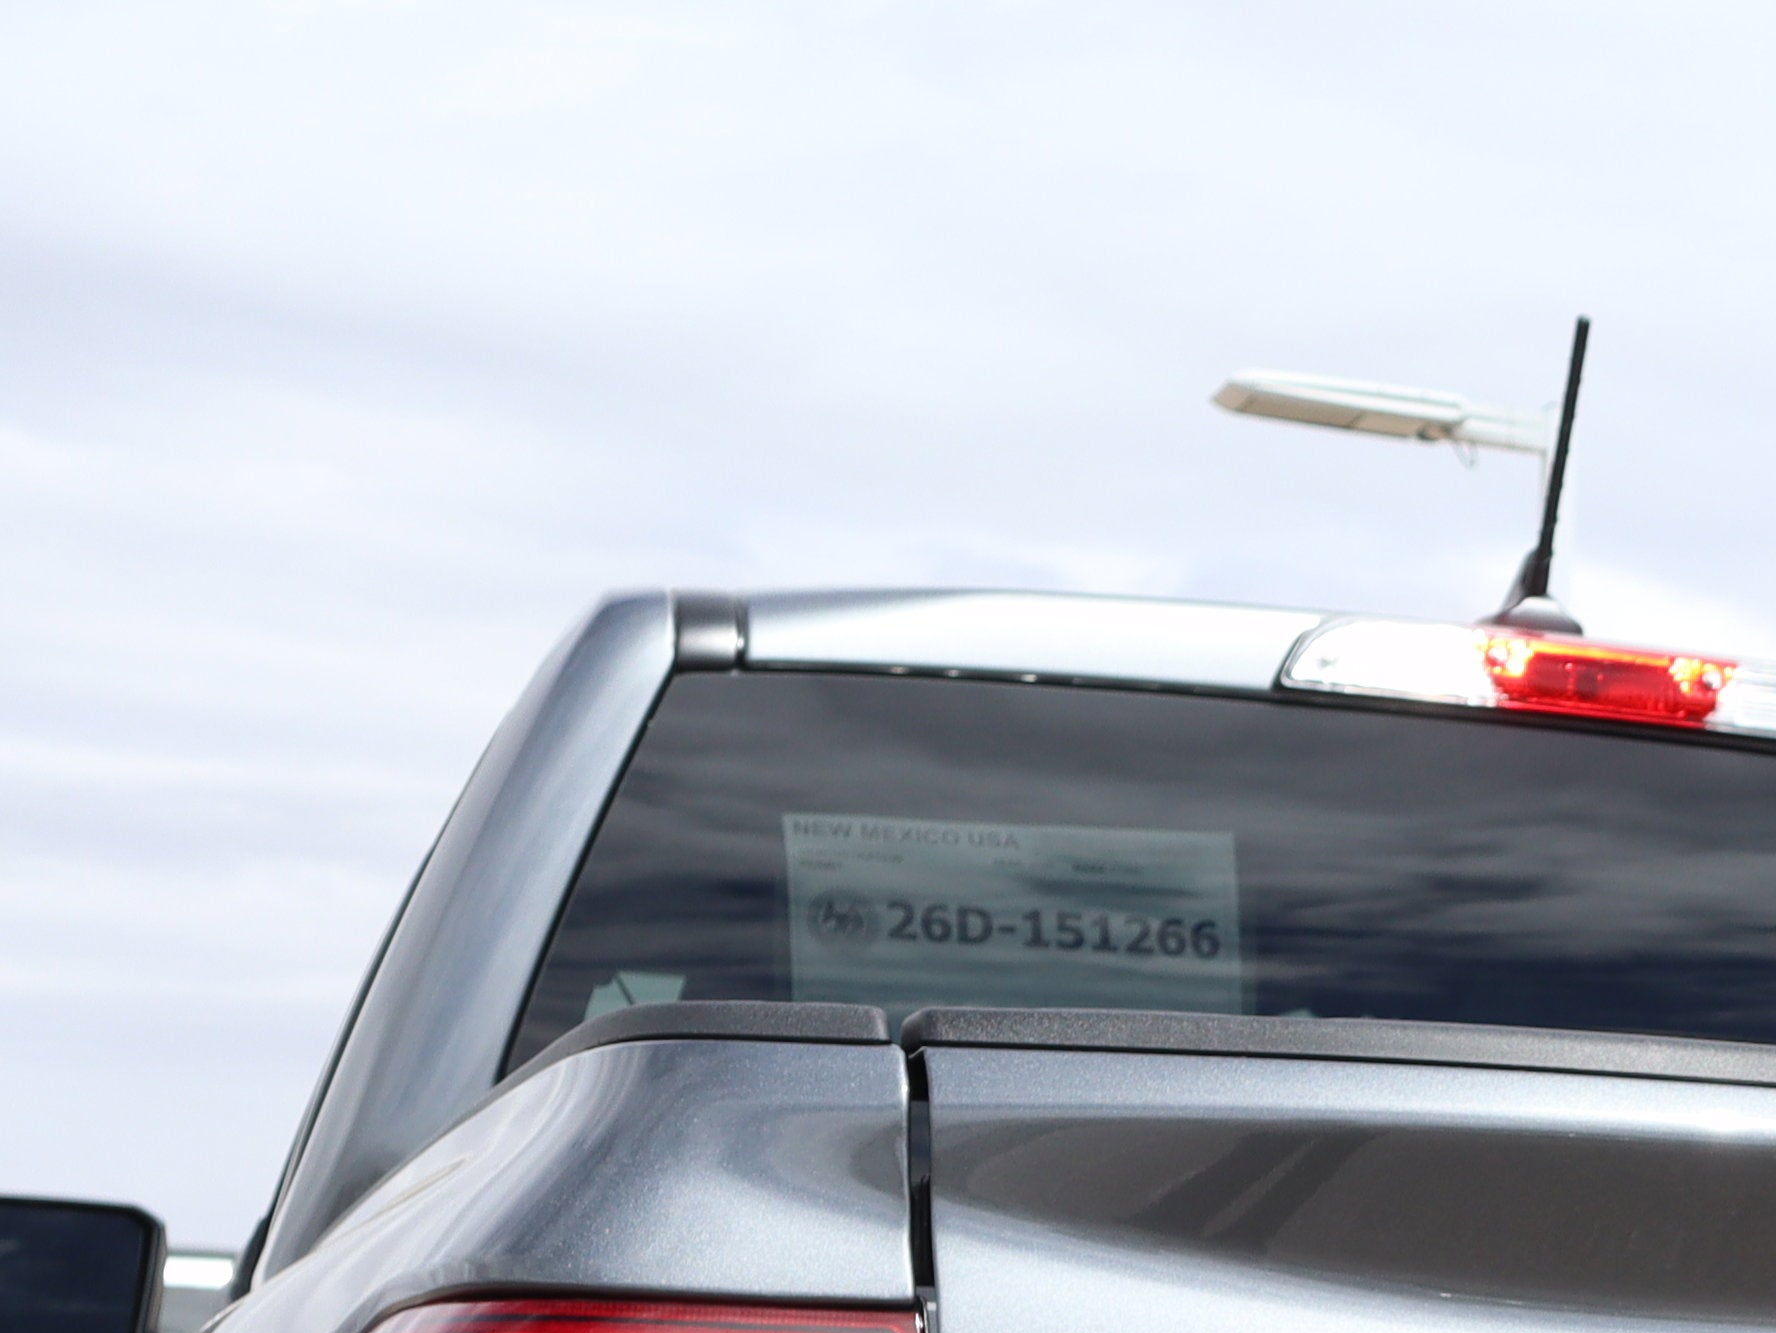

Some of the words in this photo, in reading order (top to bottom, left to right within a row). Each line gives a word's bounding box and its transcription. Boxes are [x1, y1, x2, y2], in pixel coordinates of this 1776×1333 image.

[793, 819, 851, 840] NEW
[859, 823, 960, 848] MEXICO
[966, 829, 1021, 851] USA
[886, 899, 1221, 960] 26D-151266
